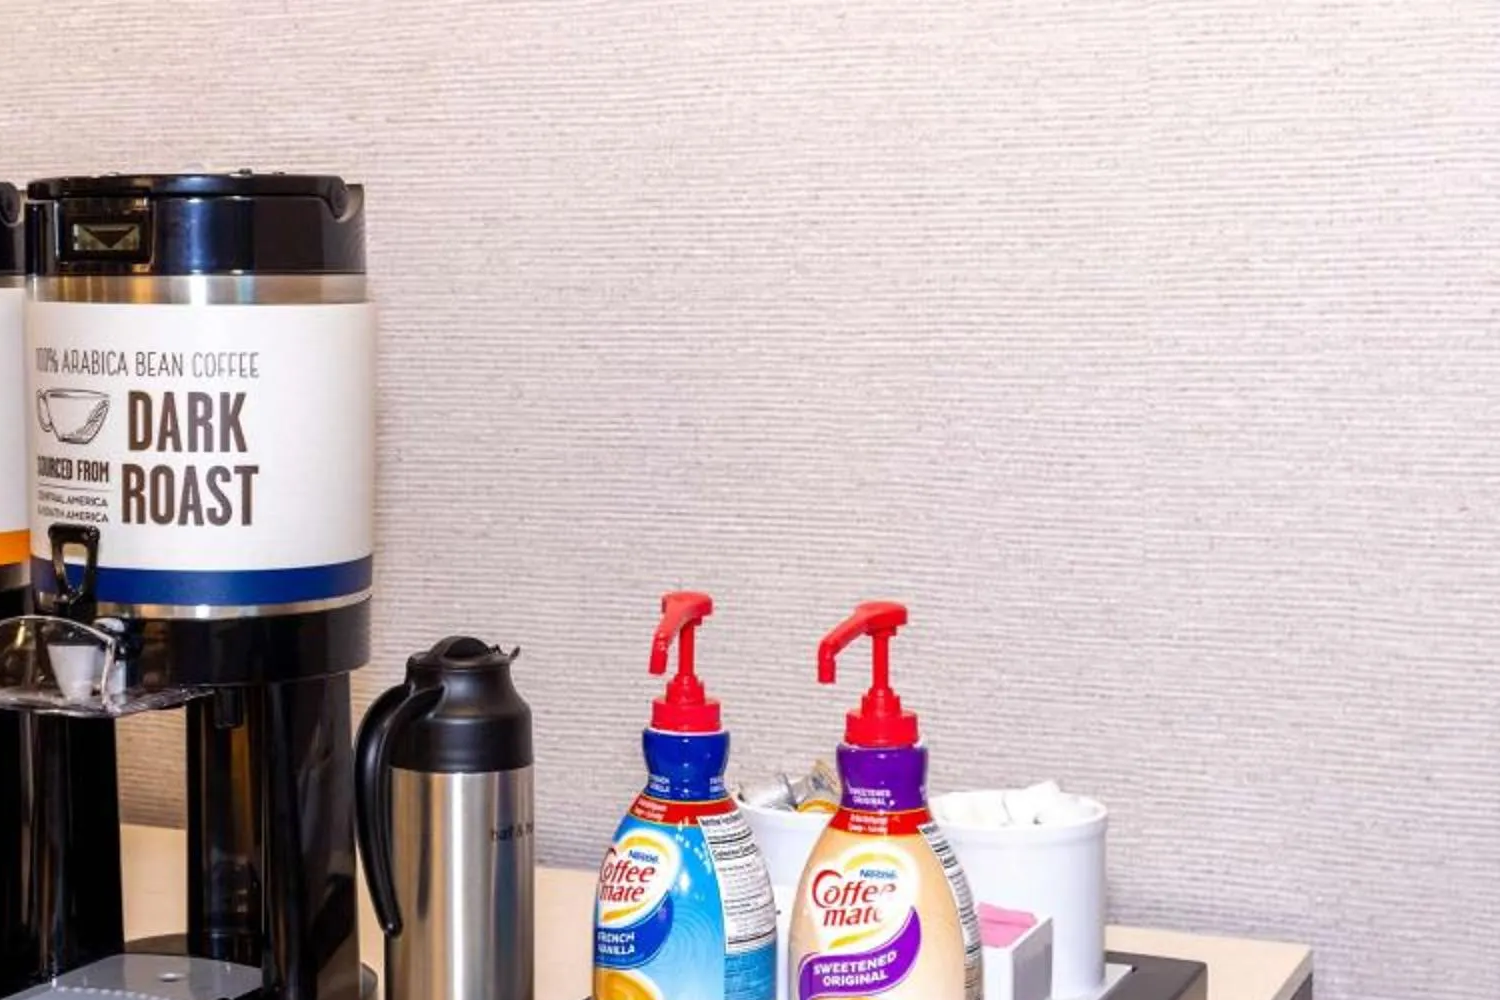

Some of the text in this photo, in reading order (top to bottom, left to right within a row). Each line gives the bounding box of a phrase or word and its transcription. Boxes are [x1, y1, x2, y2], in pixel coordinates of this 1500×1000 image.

[60, 349, 128, 377] ARABICA
[135, 351, 184, 378] BEAN
[191, 352, 260, 379] COFFEE
[128, 390, 248, 452] DARK
[77, 459, 109, 483] FROM
[67, 495, 109, 507] AMERICA
[121, 463, 260, 526] ROAST
[65, 510, 109, 523] AMERICA
[600, 847, 656, 883] Coffee
[813, 951, 897, 976] SWEETENED
[822, 969, 889, 987] ORIGINAL
